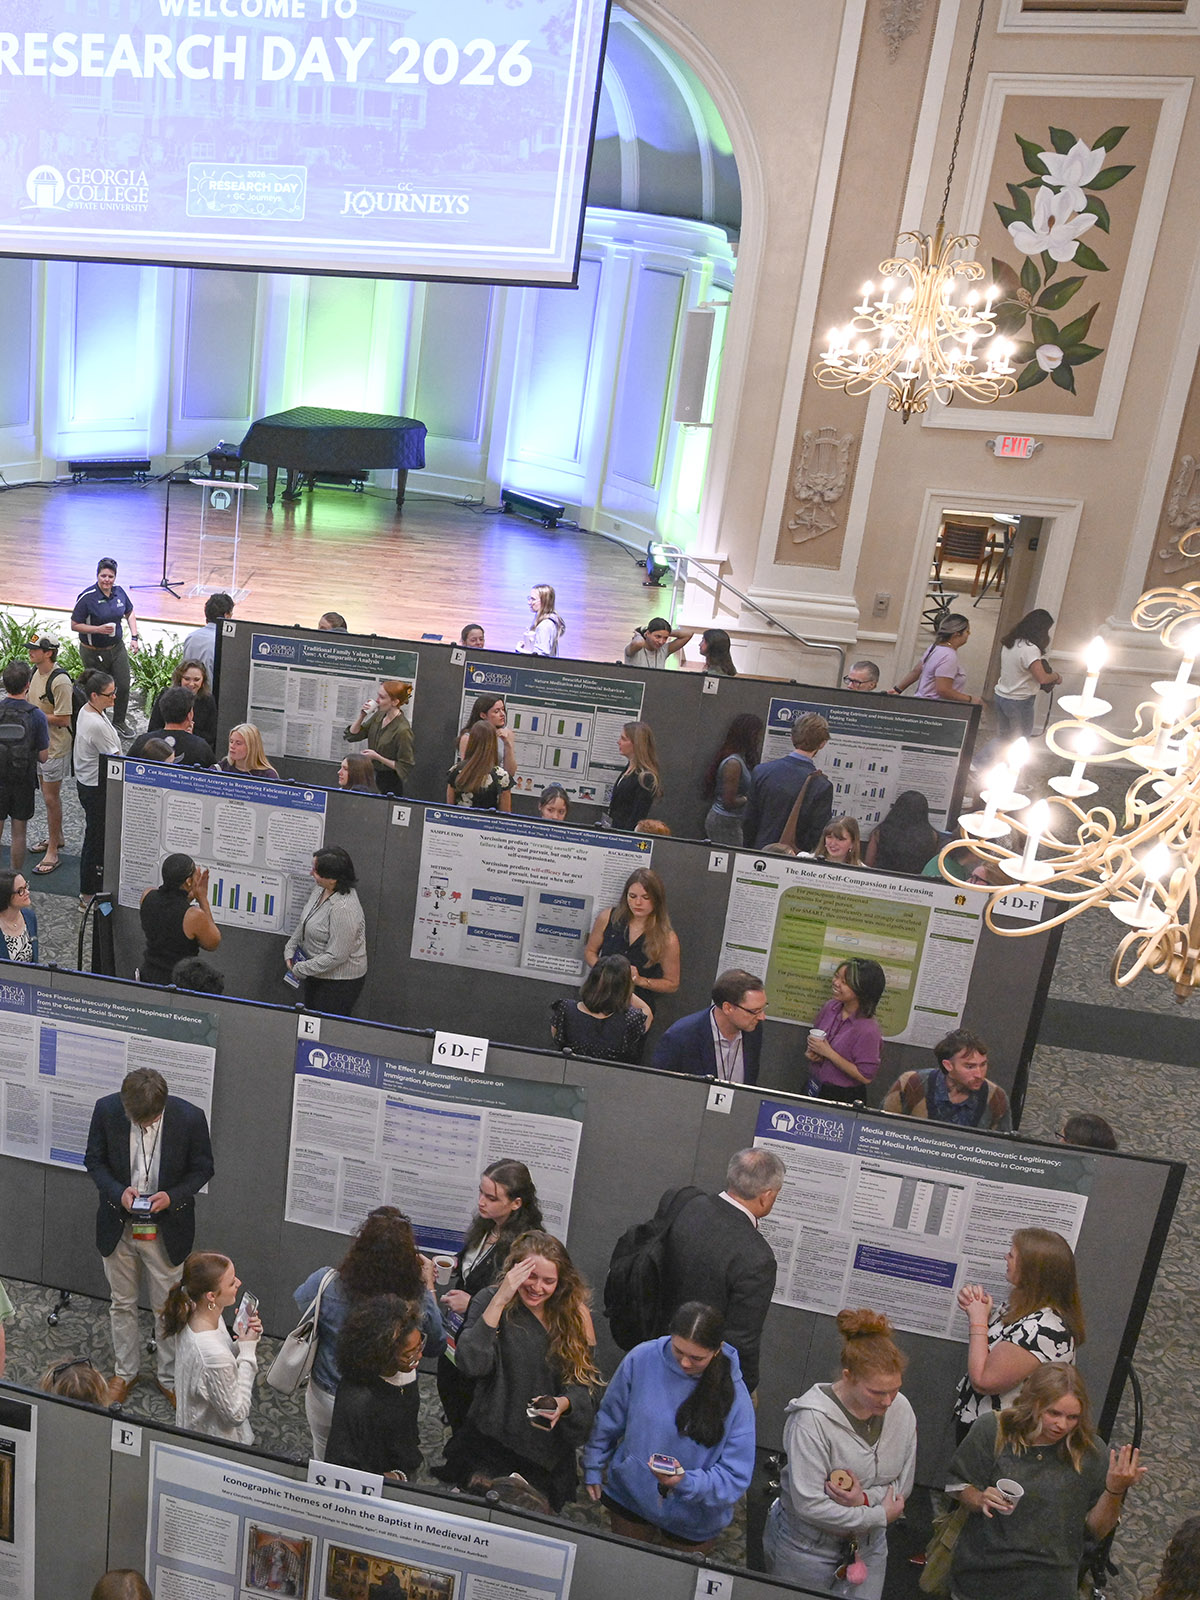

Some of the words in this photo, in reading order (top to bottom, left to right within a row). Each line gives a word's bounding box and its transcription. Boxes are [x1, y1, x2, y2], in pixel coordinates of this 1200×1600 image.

[159, 0, 305, 18] WELCOME
[262, 36, 375, 82] DAY
[387, 38, 533, 87] 2026
[66, 168, 149, 187] GEORGIA
[247, 171, 266, 179] 2026
[66, 184, 149, 204] COLLEGE
[209, 180, 270, 192] RESEARCH
[274, 183, 299, 193] DAY
[398, 182, 413, 191] GC
[233, 192, 246, 200] GC
[249, 193, 282, 203] Journeys
[100, 203, 149, 212] UNIVERSITY
[1000, 436, 1031, 456] EXIT
[225, 624, 233, 633] D
[303, 644, 332, 654] Traditional
[333, 648, 351, 657] Family
[455, 652, 462, 661] E
[322, 653, 357, 663] Comparative
[358, 656, 380, 665] Analysis
[707, 680, 715, 690] F
[111, 765, 120, 775] D
[397, 810, 406, 821] E
[714, 856, 723, 867] F
[785, 867, 799, 876] The
[800, 868, 818, 879] Role
[818, 872, 826, 880] of
[827, 873, 888, 891] Self-Compassion
[889, 882, 897, 891] in
[898, 884, 934, 898] Licensing
[999, 895, 1008, 906] 4
[1011, 896, 1039, 911] D-F
[37, 990, 52, 998] Does
[53, 993, 80, 1003] Financial
[81, 998, 112, 1010] Insecurity
[112, 1003, 135, 1013] Reduce
[136, 1007, 172, 1020] Happiness?
[173, 1013, 202, 1024] Evidence
[37, 999, 52, 1007] from
[63, 1003, 87, 1013] General
[88, 1007, 106, 1017] Social
[107, 1011, 129, 1022] Survey
[304, 1022, 314, 1034] E
[329, 1051, 371, 1067] GEORGIA
[438, 1042, 447, 1054] 6
[451, 1043, 483, 1062] D-F
[329, 1059, 371, 1074] COLLEGE
[385, 1062, 397, 1070] The
[398, 1064, 416, 1074] Effect
[426, 1069, 463, 1082] Information
[464, 1076, 494, 1087] Exposure
[384, 1071, 421, 1085] Immigration
[422, 1078, 451, 1090] Approval
[714, 1092, 726, 1105] F
[796, 1114, 844, 1131] GEORGIA
[795, 1124, 844, 1139] COLLEGE
[861, 1126, 883, 1136] Media
[884, 1129, 912, 1142] Effects,
[913, 1135, 958, 1151] Polarization,
[959, 1144, 974, 1153] and
[975, 1147, 1018, 1161] Democratic
[1019, 1154, 1062, 1168] Legitimacy:
[859, 1136, 881, 1146] Social
[882, 1140, 905, 1150] Media
[906, 1143, 940, 1156] Influence
[941, 1150, 956, 1160] and
[957, 1153, 1000, 1168] Confidence
[1001, 1161, 1008, 1169] in
[1009, 1163, 1045, 1176] Congress
[861, 1160, 881, 1169] Results
[120, 1428, 133, 1446] E
[334, 1478, 375, 1496] DF
[223, 1475, 282, 1498] Iconographic
[283, 1491, 320, 1508] Themes
[322, 1502, 333, 1511] of
[334, 1504, 357, 1516] John
[359, 1510, 376, 1521] the
[378, 1514, 411, 1530] Baptist
[414, 1521, 423, 1531] in
[426, 1525, 471, 1543] Medieval
[473, 1536, 489, 1548] Art
[705, 1579, 722, 1596] F
